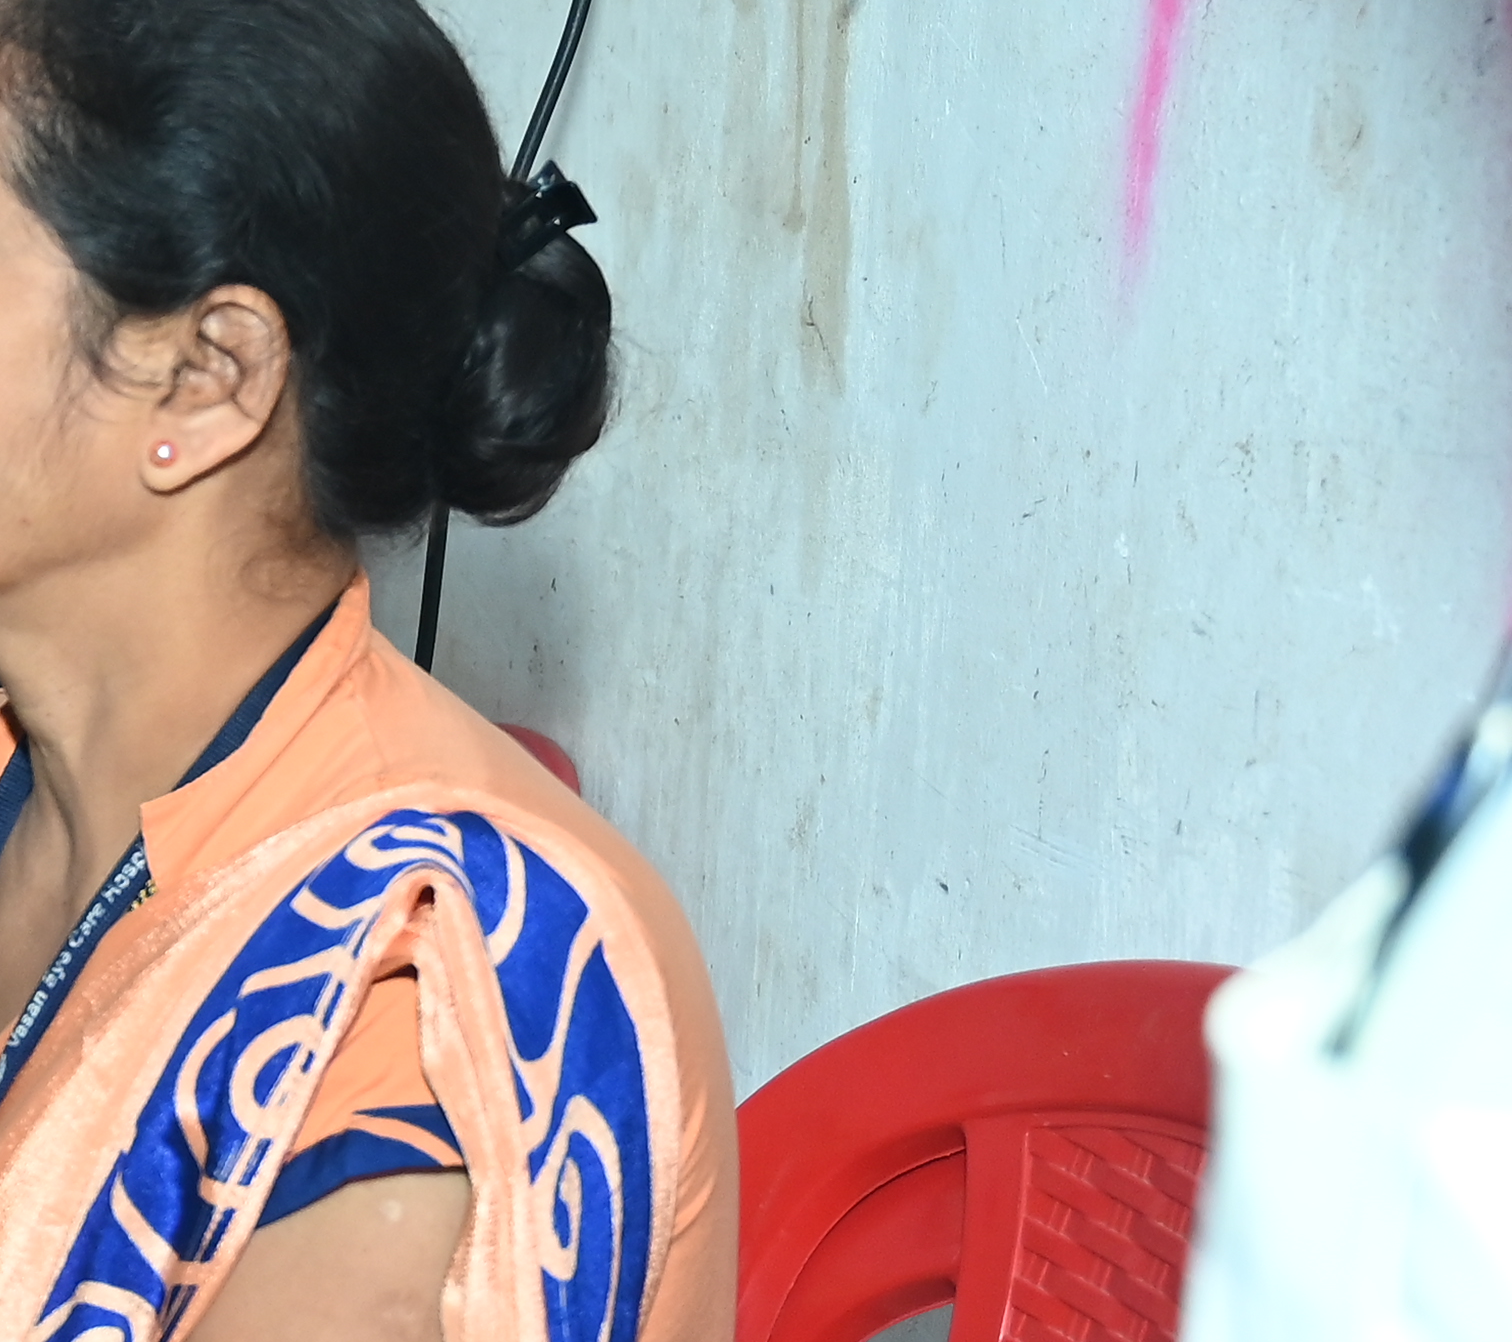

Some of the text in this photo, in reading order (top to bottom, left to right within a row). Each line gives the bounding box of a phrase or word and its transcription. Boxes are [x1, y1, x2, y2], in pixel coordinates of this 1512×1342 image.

[6, 988, 48, 1049] Vasan
[66, 901, 107, 949] Care
[102, 841, 149, 913] Hosp
